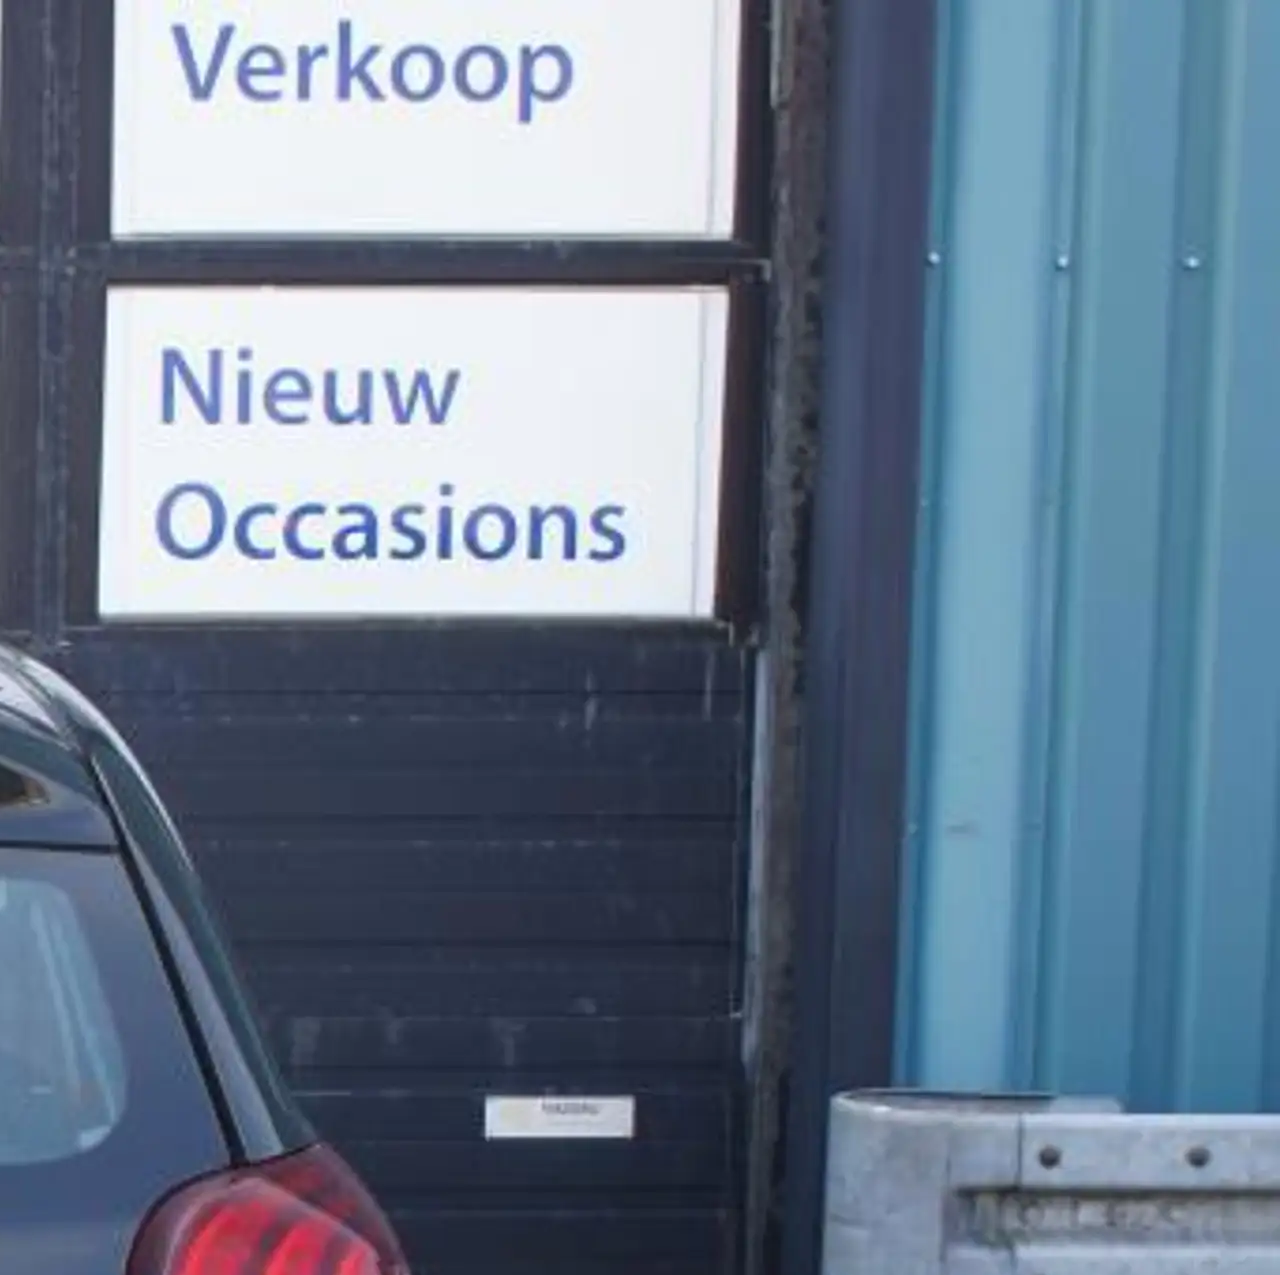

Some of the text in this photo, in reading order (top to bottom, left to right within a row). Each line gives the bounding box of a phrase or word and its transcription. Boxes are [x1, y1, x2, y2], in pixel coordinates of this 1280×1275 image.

[171, 19, 574, 124] Verkoop
[159, 347, 461, 425] Nieuw
[155, 482, 627, 562] Occasions
